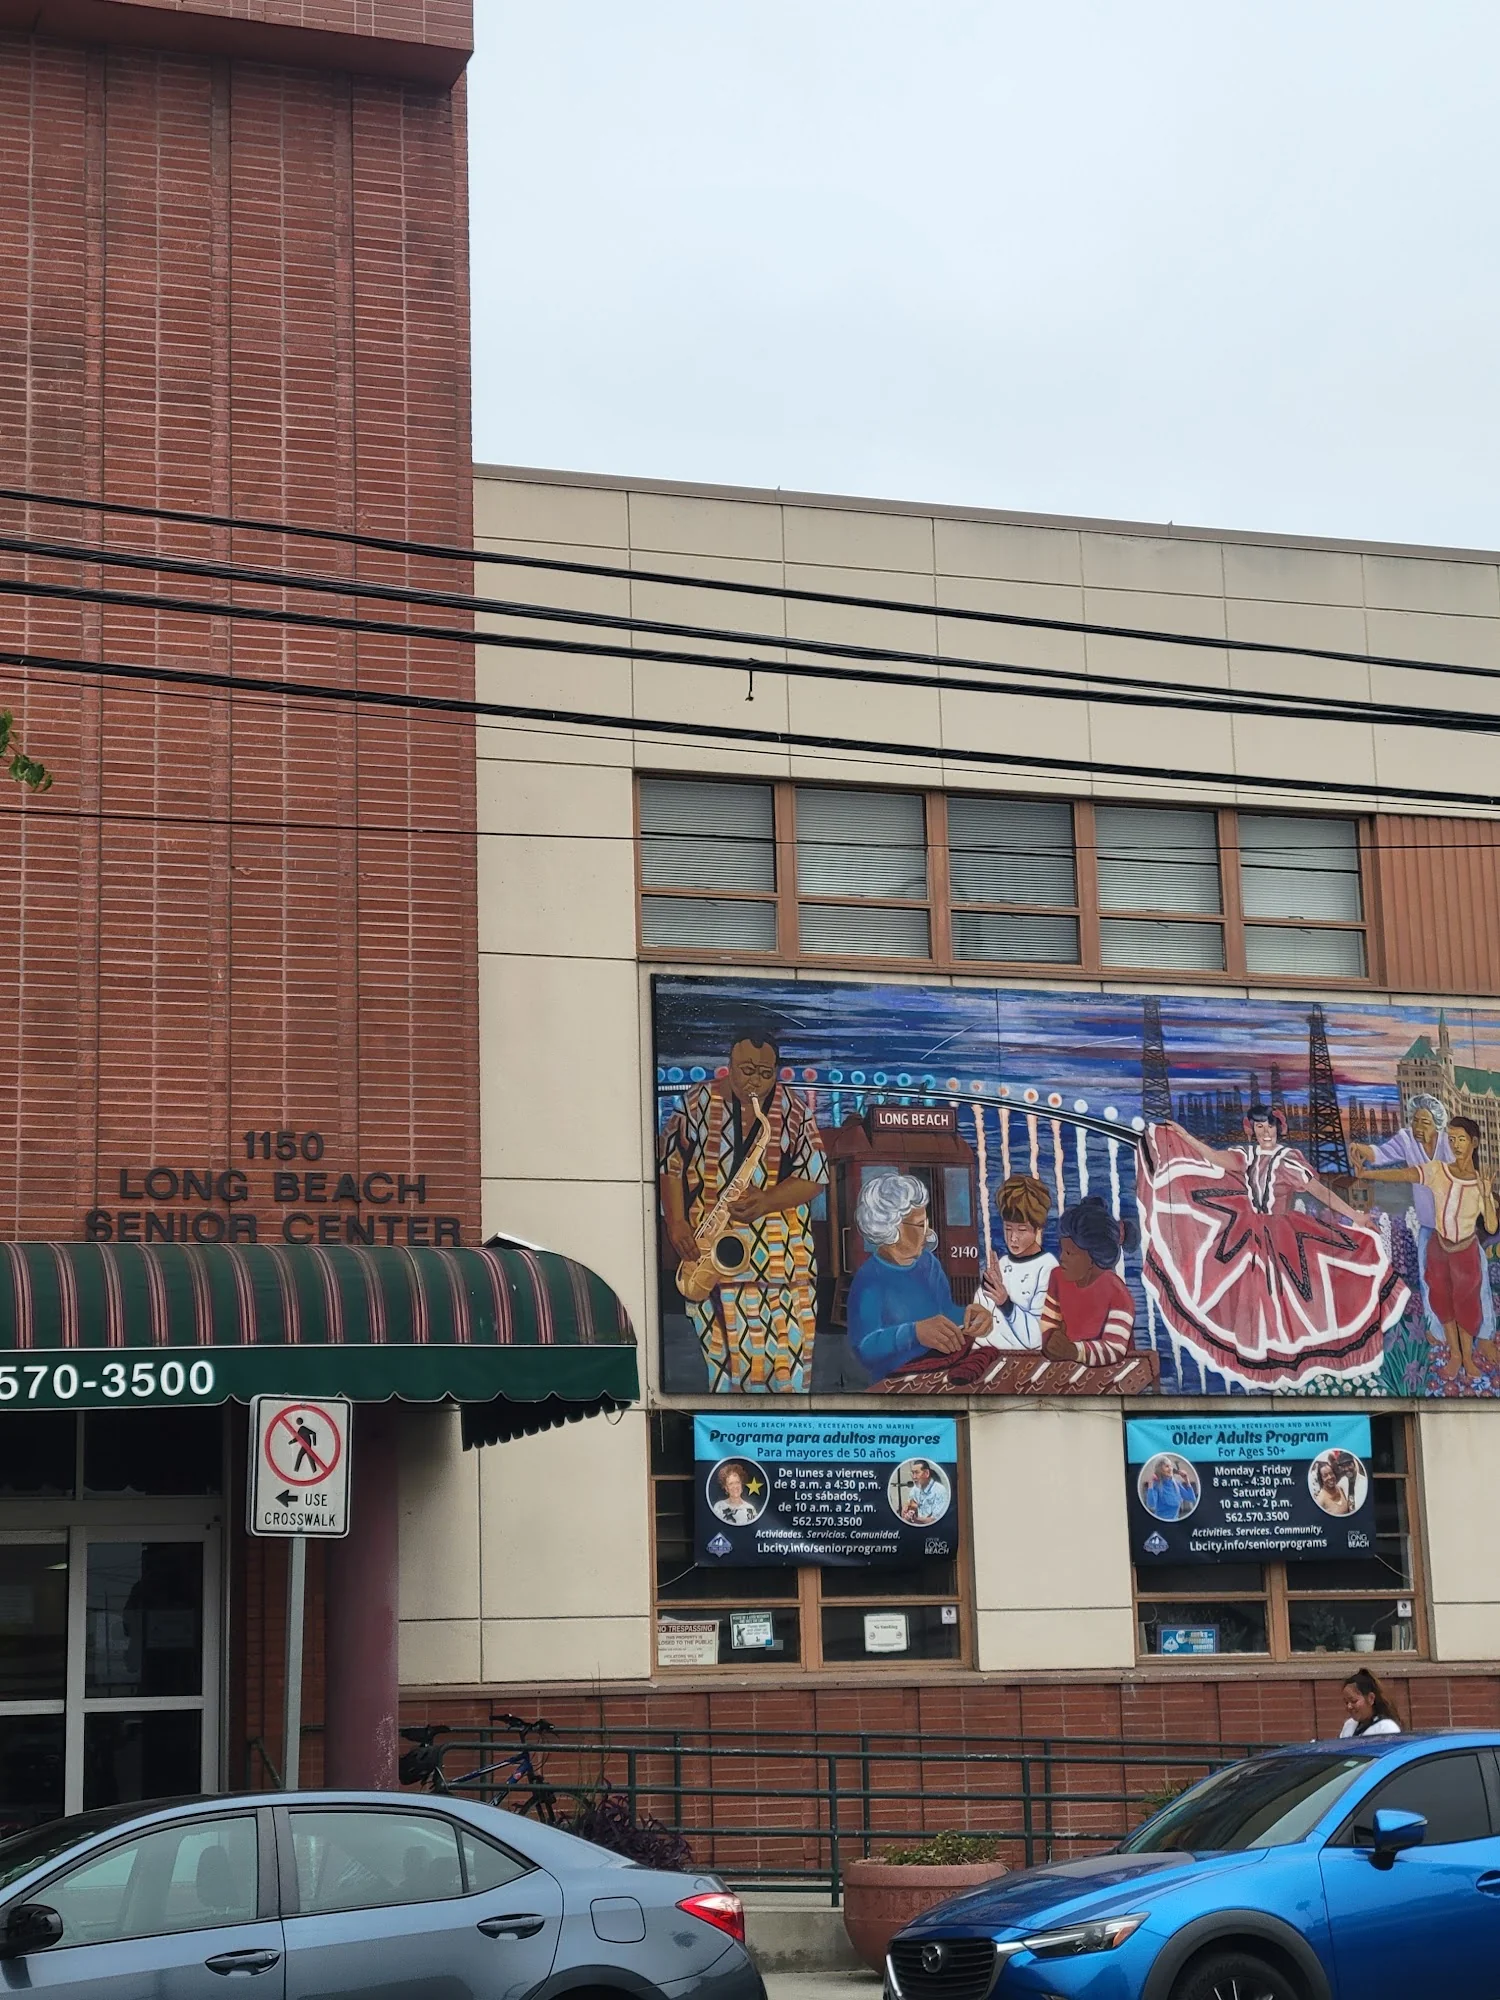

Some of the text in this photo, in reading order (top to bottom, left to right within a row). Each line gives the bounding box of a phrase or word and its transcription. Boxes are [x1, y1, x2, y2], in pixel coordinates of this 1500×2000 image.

[879, 1112, 949, 1126] LONG BEACH
[243, 1131, 324, 1161] 1150
[119, 1167, 427, 1204] LONG BEACH
[85, 1210, 462, 1247] SENIOR CENTER
[950, 1245, 979, 1259] 2140
[0, 1360, 215, 1400] 570-3500
[710, 1429, 941, 1448] Programa para adultos mayores
[1172, 1430, 1329, 1447] Older Adults Program
[757, 1447, 896, 1460] Para mayores de 50 años
[1218, 1446, 1286, 1459] For Ages 50+
[778, 1468, 877, 1480] De lunes a viernes,
[1214, 1465, 1255, 1478] Monday
[1262, 1465, 1292, 1475] Friday
[774, 1479, 881, 1492] de 8 a.m. a 4:30 p.m.
[1212, 1477, 1220, 1487] 8
[1221, 1479, 1244, 1487] a.m.
[1251, 1476, 1271, 1486] 4:30
[1273, 1478, 1295, 1488] p.m.
[794, 1491, 862, 1503] Los sábados,
[1232, 1487, 1277, 1499] Saturday
[305, 1493, 328, 1507] USE
[1220, 1499, 1231, 1509] 10
[1233, 1500, 1255, 1509] a.m.
[1262, 1498, 1269, 1508] 2
[1271, 1499, 1293, 1510] p.m.
[778, 1502, 877, 1515] de 10 a.m. a 2 p.m.
[264, 1512, 336, 1527] CROSSWALK
[792, 1516, 863, 1527] 562.570.3500
[1225, 1511, 1290, 1523] 562.570.3500
[755, 1529, 901, 1539] Actividades. Servicios. Comunidad.
[1191, 1524, 1323, 1538] Activities. Services. Community.
[757, 1543, 898, 1556] Lbcity.info/seniorprograms
[1189, 1539, 1328, 1553] Lbcity.info/seniorprograms
[1348, 1540, 1370, 1548] BEACH
[668, 1624, 713, 1633] TRESPASSING
